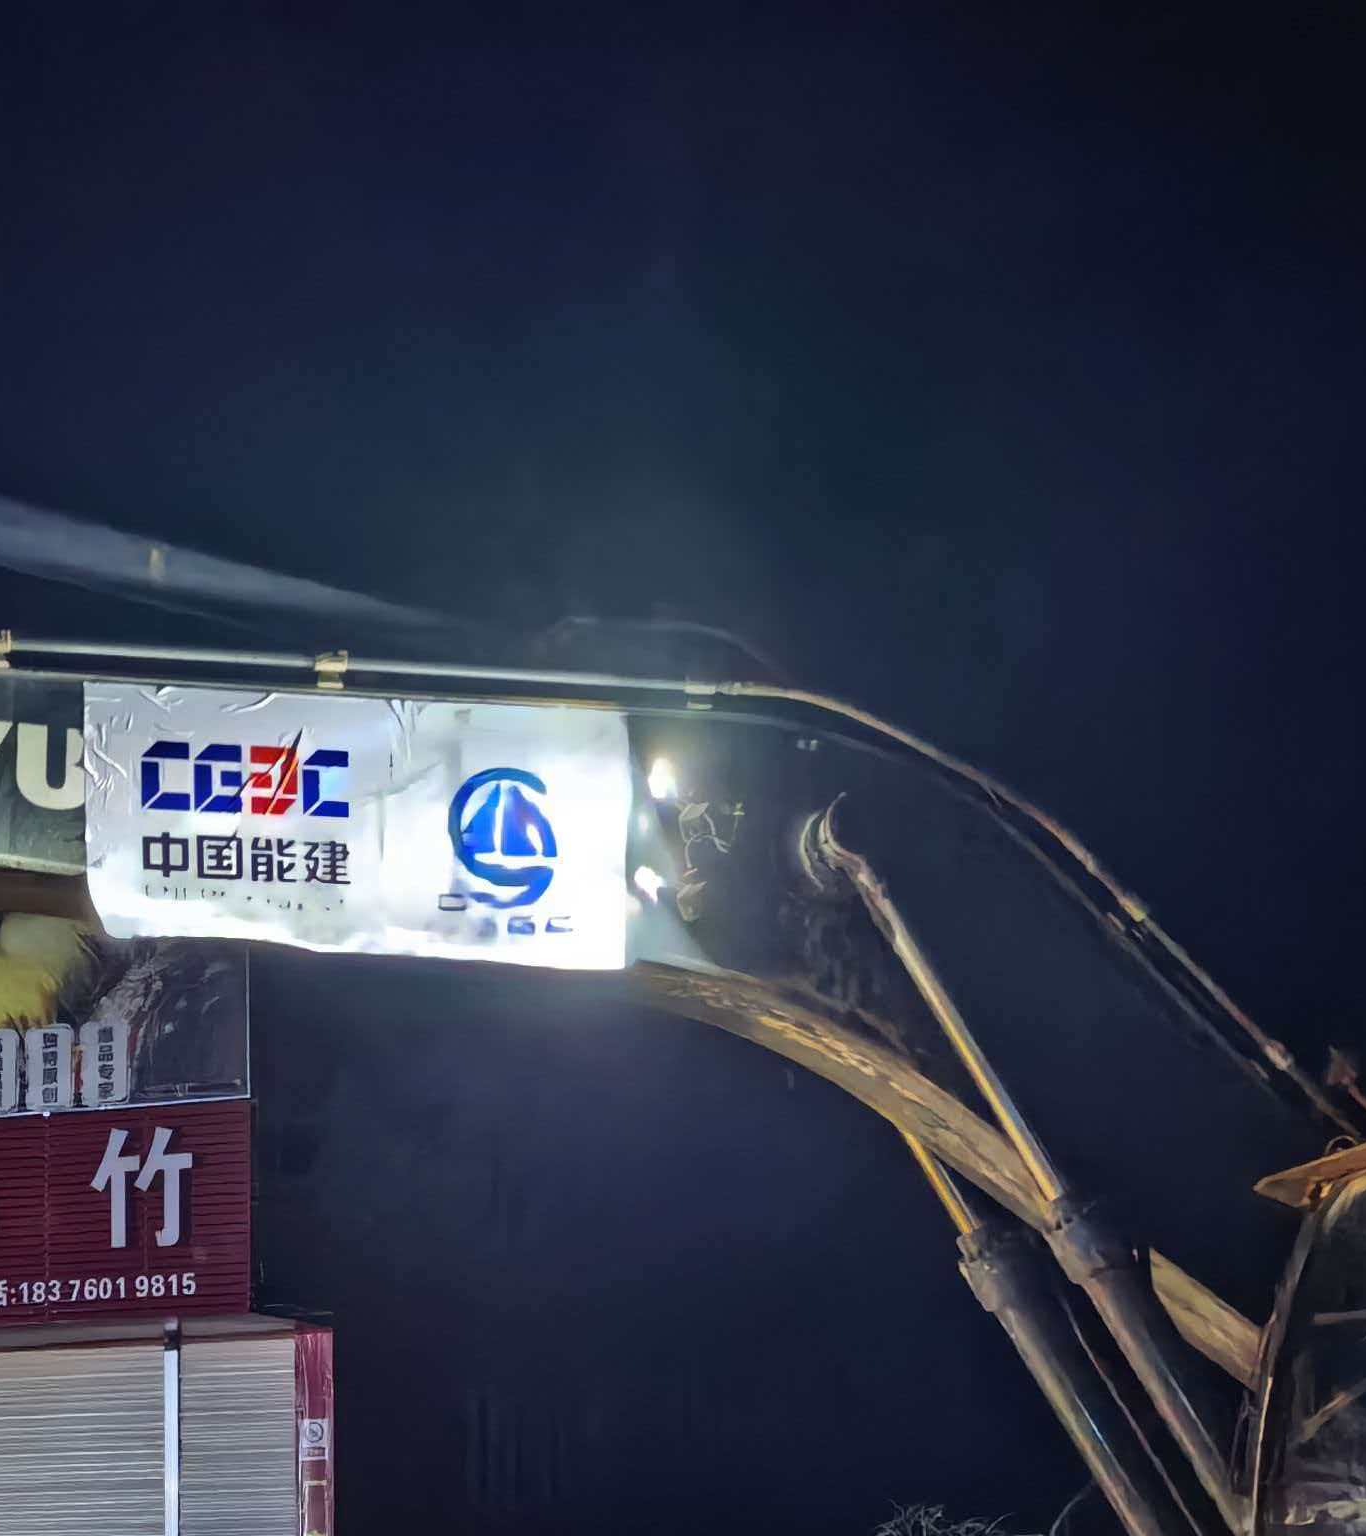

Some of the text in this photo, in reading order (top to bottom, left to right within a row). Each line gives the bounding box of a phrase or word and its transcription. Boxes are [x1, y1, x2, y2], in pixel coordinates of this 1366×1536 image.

[141, 831, 352, 885] 中国能建
[69, 1275, 126, 1301] 7601
[135, 1273, 196, 1297] 9815
